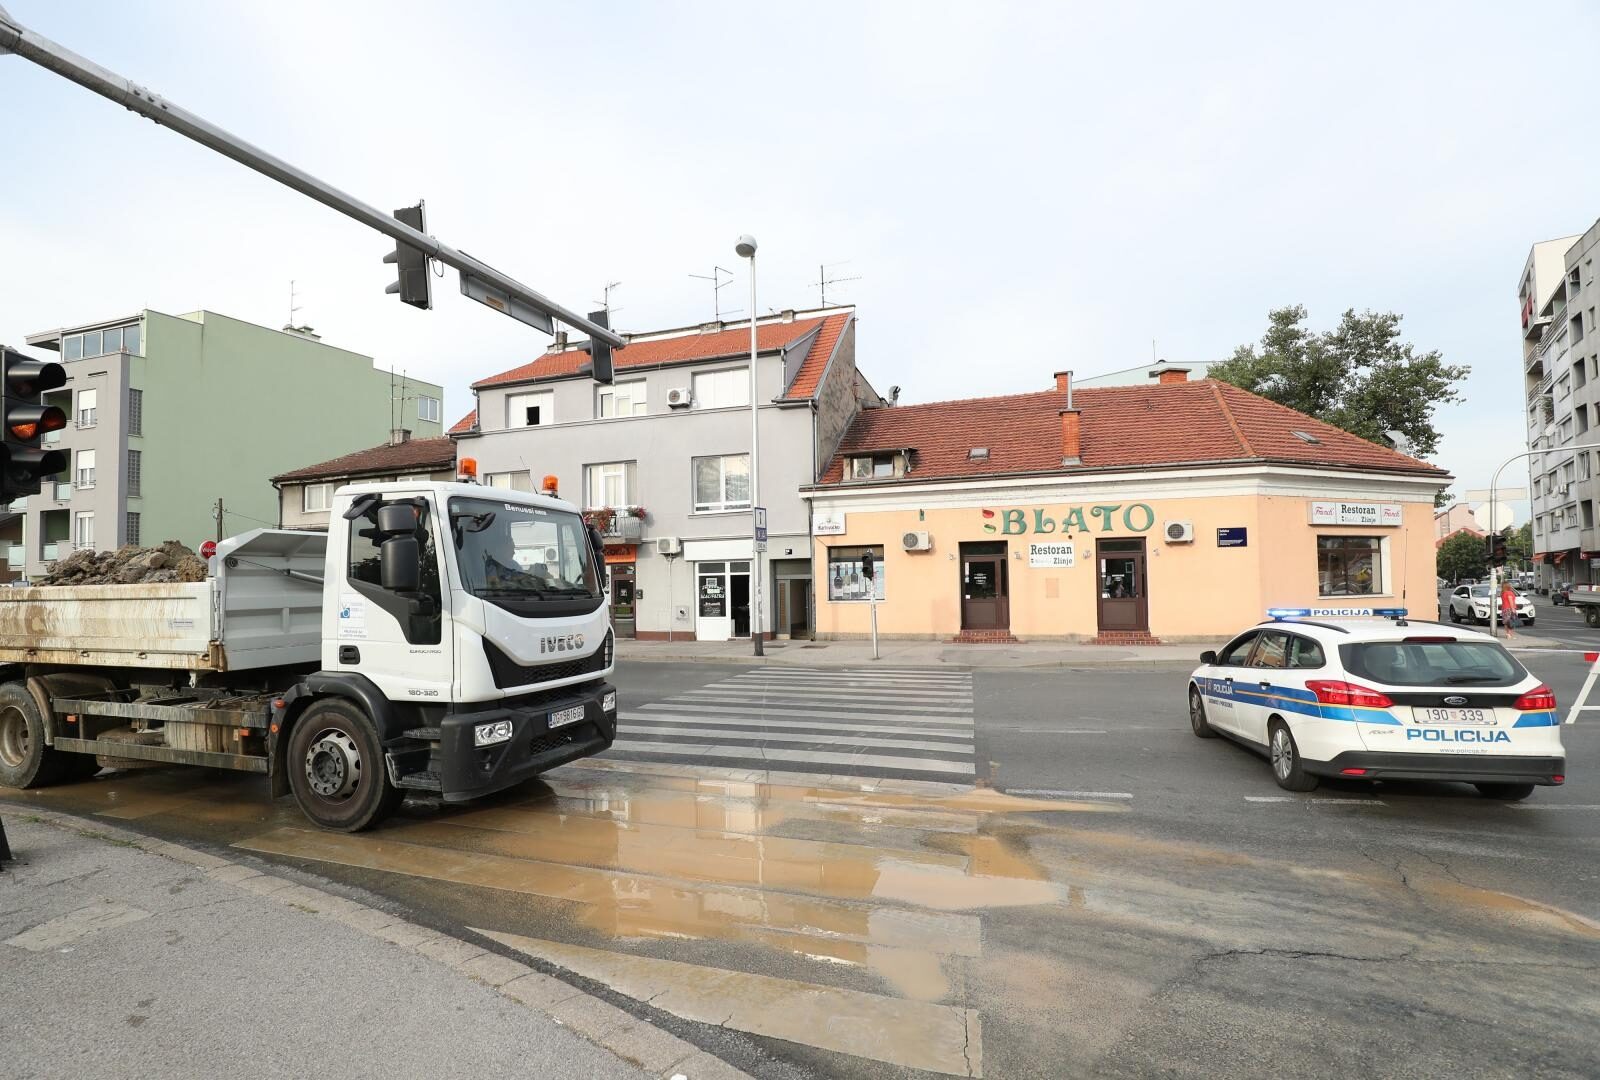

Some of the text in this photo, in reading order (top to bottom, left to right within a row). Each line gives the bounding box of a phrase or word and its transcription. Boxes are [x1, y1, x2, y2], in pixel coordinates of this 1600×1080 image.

[1341, 504, 1376, 515] Restoran
[1001, 503, 1155, 535] BLATO
[1030, 544, 1073, 555] Restoran
[540, 633, 585, 654] IVECO
[1426, 709, 1484, 721] 190 339
[1407, 728, 1511, 743] POLICIJA
